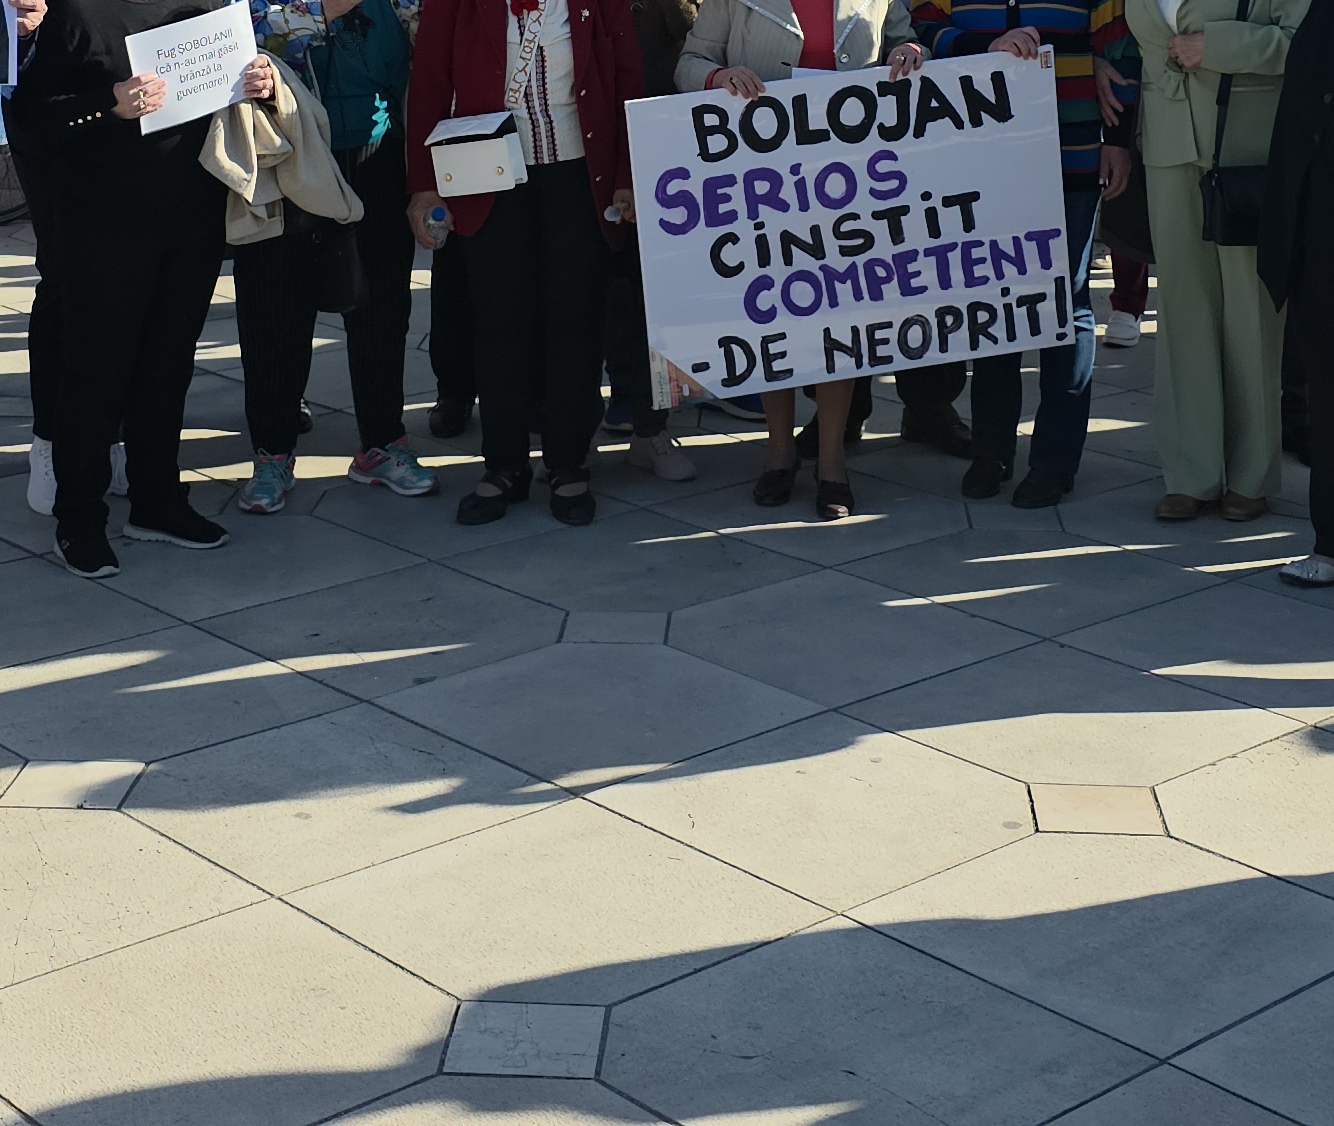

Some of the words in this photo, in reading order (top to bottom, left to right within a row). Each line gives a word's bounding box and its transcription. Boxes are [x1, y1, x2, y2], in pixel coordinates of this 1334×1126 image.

[156, 46, 177, 61] Fug
[173, 56, 197, 71] n-au
[198, 50, 217, 63] mai
[213, 62, 223, 73] la
[691, 70, 1015, 163] BOLOJAN
[743, 228, 1062, 325] COMPETENT
